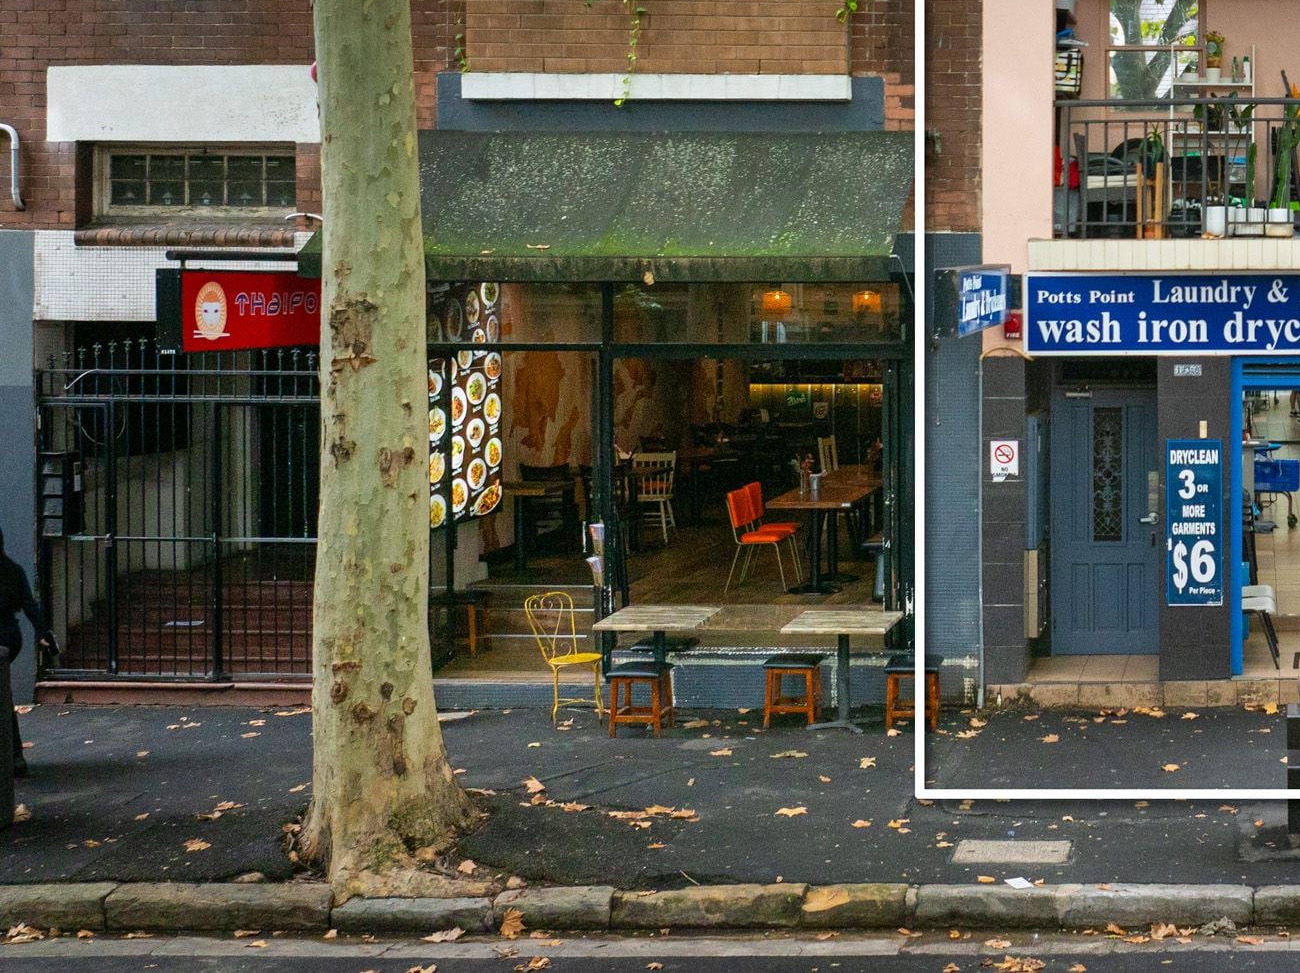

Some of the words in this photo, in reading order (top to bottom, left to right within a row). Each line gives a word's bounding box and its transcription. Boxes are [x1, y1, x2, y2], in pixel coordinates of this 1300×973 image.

[1037, 290, 1082, 305] Potts
[1089, 290, 1135, 304] Point
[1152, 279, 1257, 310] Laundry
[1267, 279, 1289, 304] &
[1037, 311, 1122, 344] wash
[1138, 311, 1209, 344] iron
[1170, 450, 1218, 465] DRYCLEAN
[1178, 469, 1196, 500] 3
[1197, 484, 1208, 493] OR
[1182, 505, 1206, 518] MORE
[1172, 522, 1216, 535] GARMENTS
[1173, 540, 1216, 595] $6
[1189, 587, 1199, 595] Per
